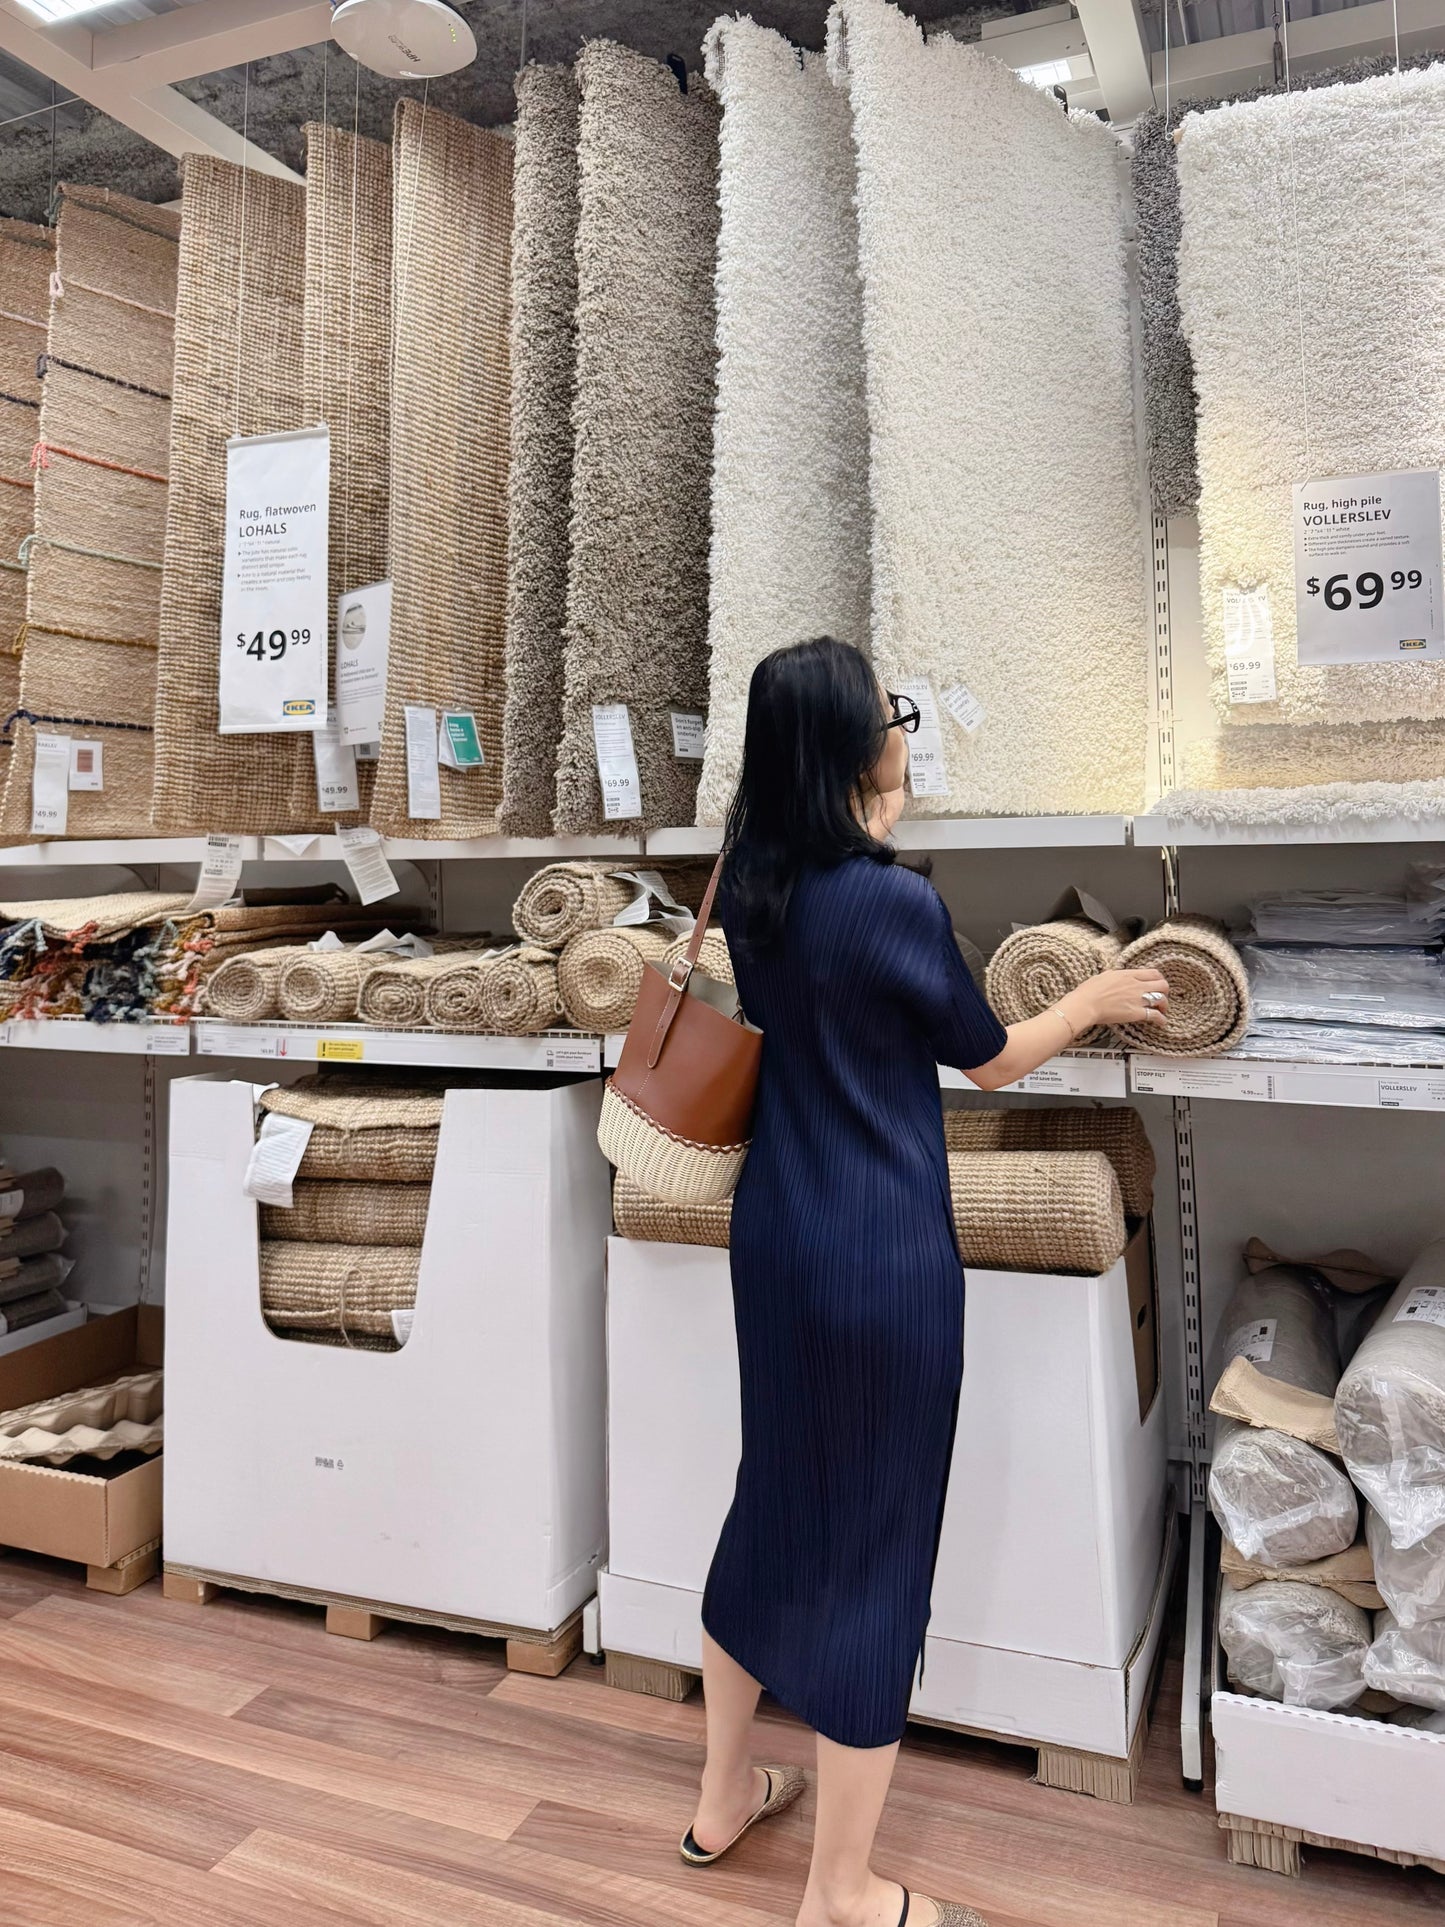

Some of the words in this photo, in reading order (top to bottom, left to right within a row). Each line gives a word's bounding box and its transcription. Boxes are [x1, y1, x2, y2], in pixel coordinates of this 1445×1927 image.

[240, 509, 262, 521] Rug,
[265, 503, 316, 516] flatwoven
[1303, 502, 1328, 512] Rug,
[1332, 498, 1358, 510] high
[1361, 496, 1382, 508] pile
[1303, 509, 1391, 526] VOLLERSLEV
[239, 522, 287, 537] LOHALS
[1390, 570, 1423, 590] 99
[291, 629, 311, 645] 99
[1401, 640, 1425, 648] IKEA
[285, 702, 314, 713] IKEA
